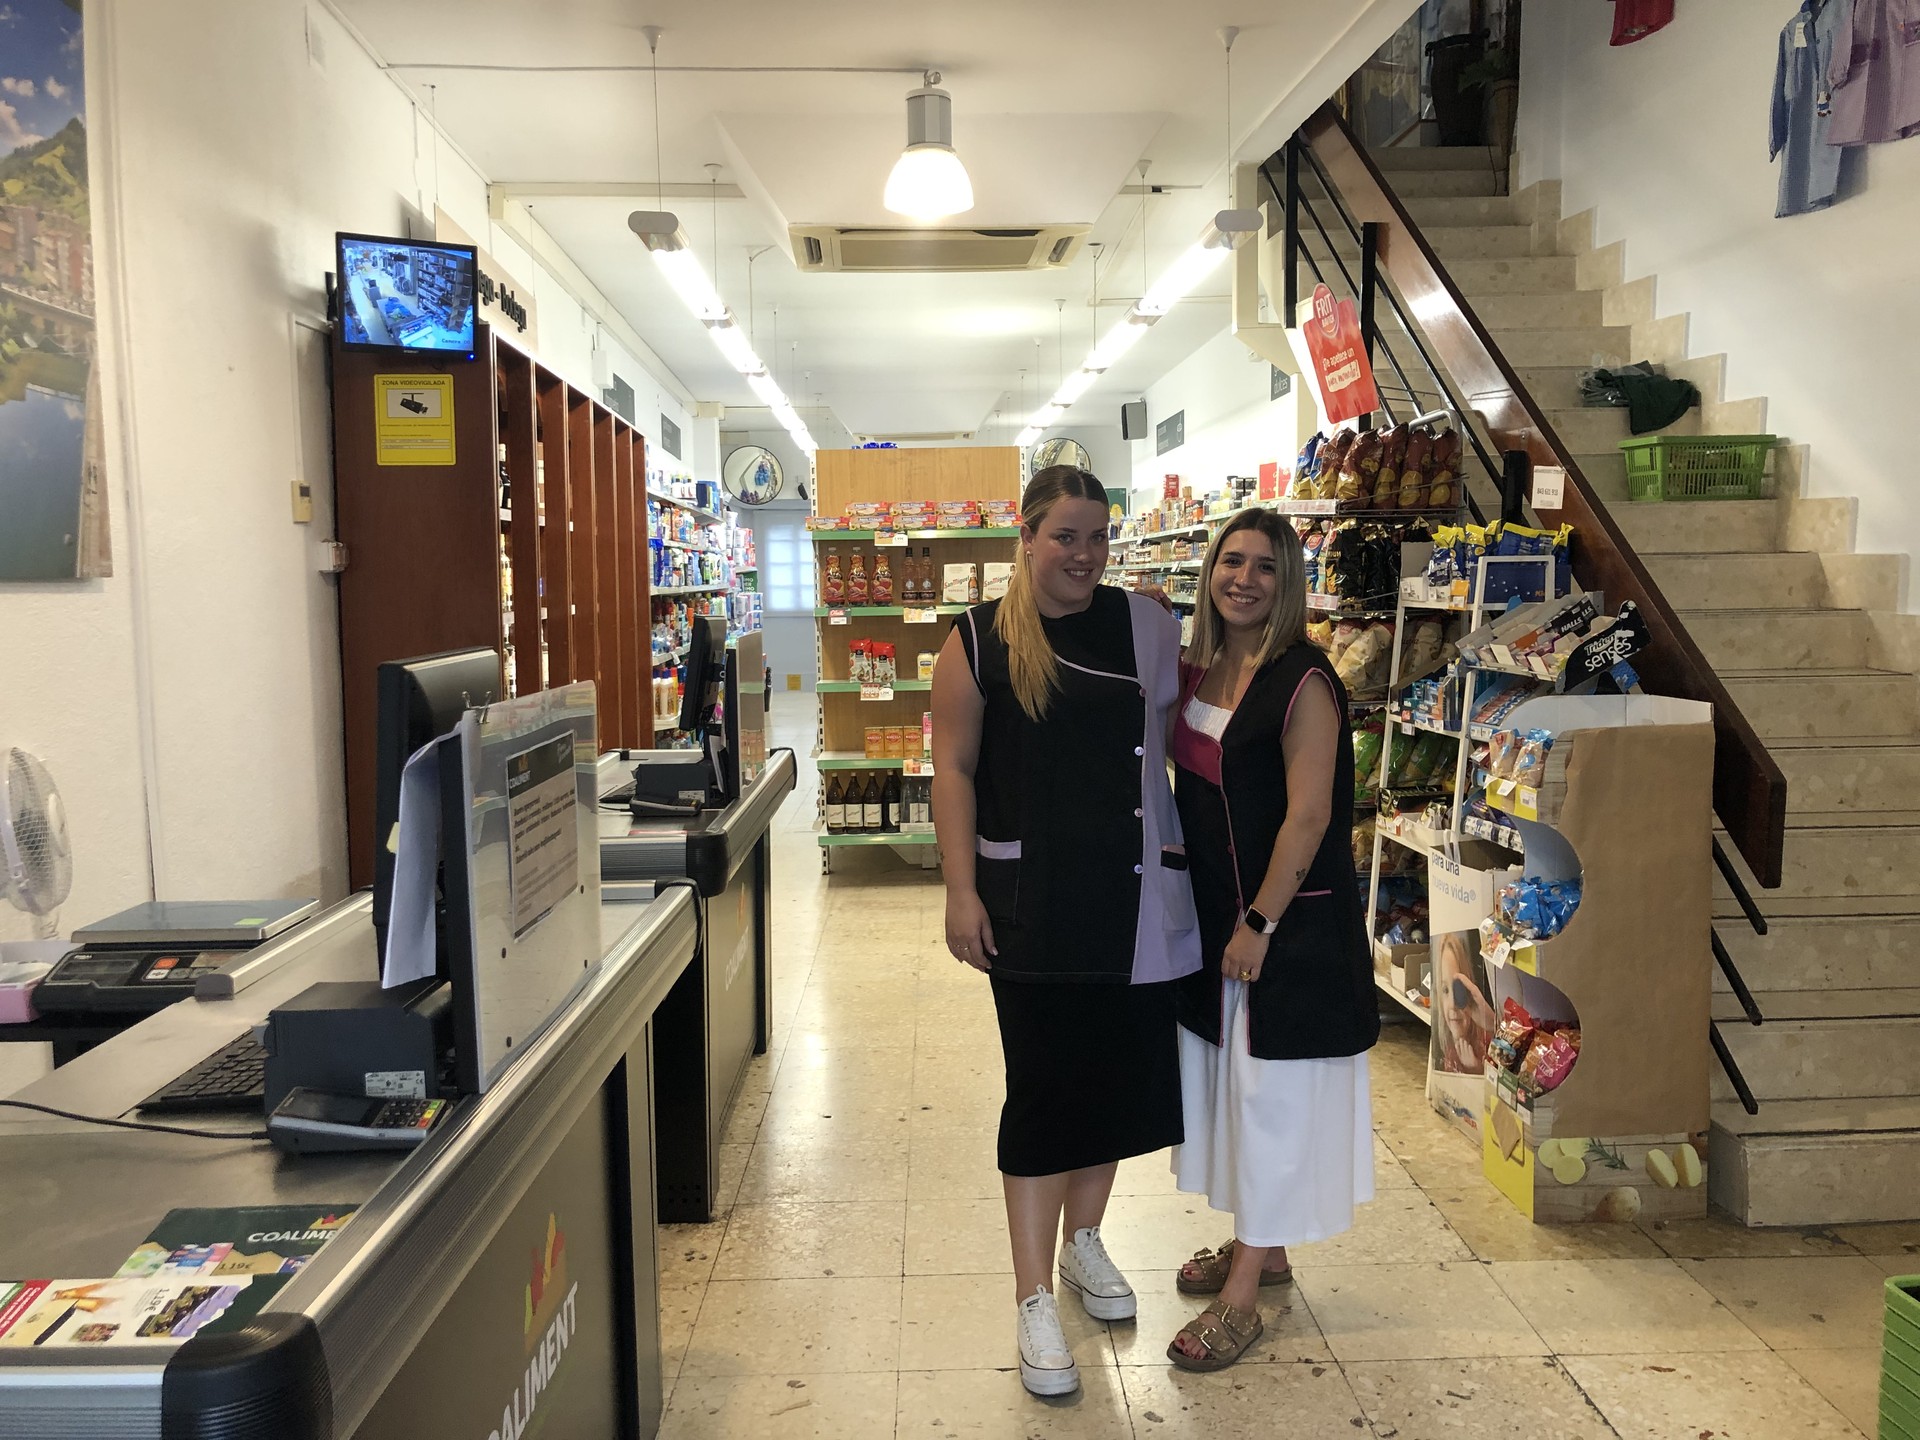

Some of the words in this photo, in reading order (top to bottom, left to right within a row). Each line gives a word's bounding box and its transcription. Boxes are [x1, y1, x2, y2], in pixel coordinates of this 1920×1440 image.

[1316, 293, 1332, 319] FRIT
[1330, 350, 1348, 368] apetece
[1582, 605, 1594, 617] LLS
[1561, 616, 1584, 632] HALLS
[1584, 632, 1617, 656] Triden
[1585, 638, 1632, 672] senses
[1432, 852, 1444, 869] para
[1445, 860, 1460, 876] una
